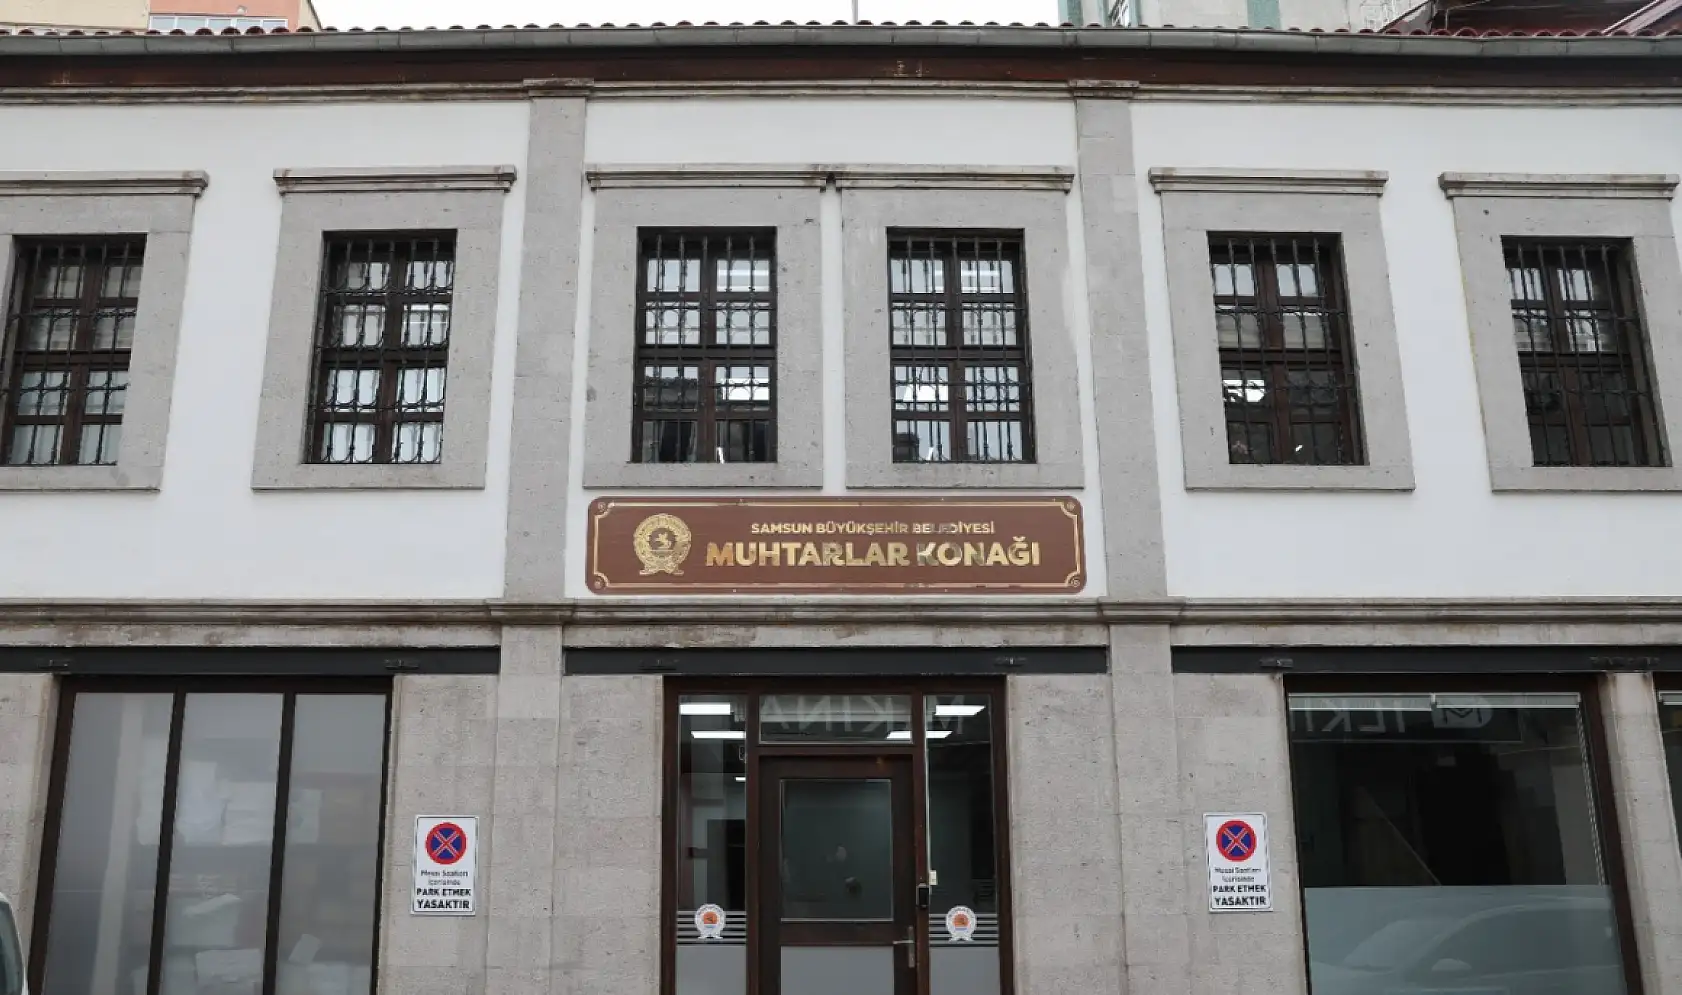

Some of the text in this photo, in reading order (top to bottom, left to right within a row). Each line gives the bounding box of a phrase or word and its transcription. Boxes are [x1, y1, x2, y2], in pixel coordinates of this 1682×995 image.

[751, 520, 996, 536] SAMSUN BÜYÜKŞEHİR BELEDİYESİ
[706, 536, 1040, 567] MUHTARLAR KONAĞI
[416, 888, 471, 896] PARK ETMEK
[1212, 884, 1267, 893] PARK ETMEK
[416, 899, 470, 909] YASAKTIR
[1214, 896, 1267, 906] YASAKTIR
